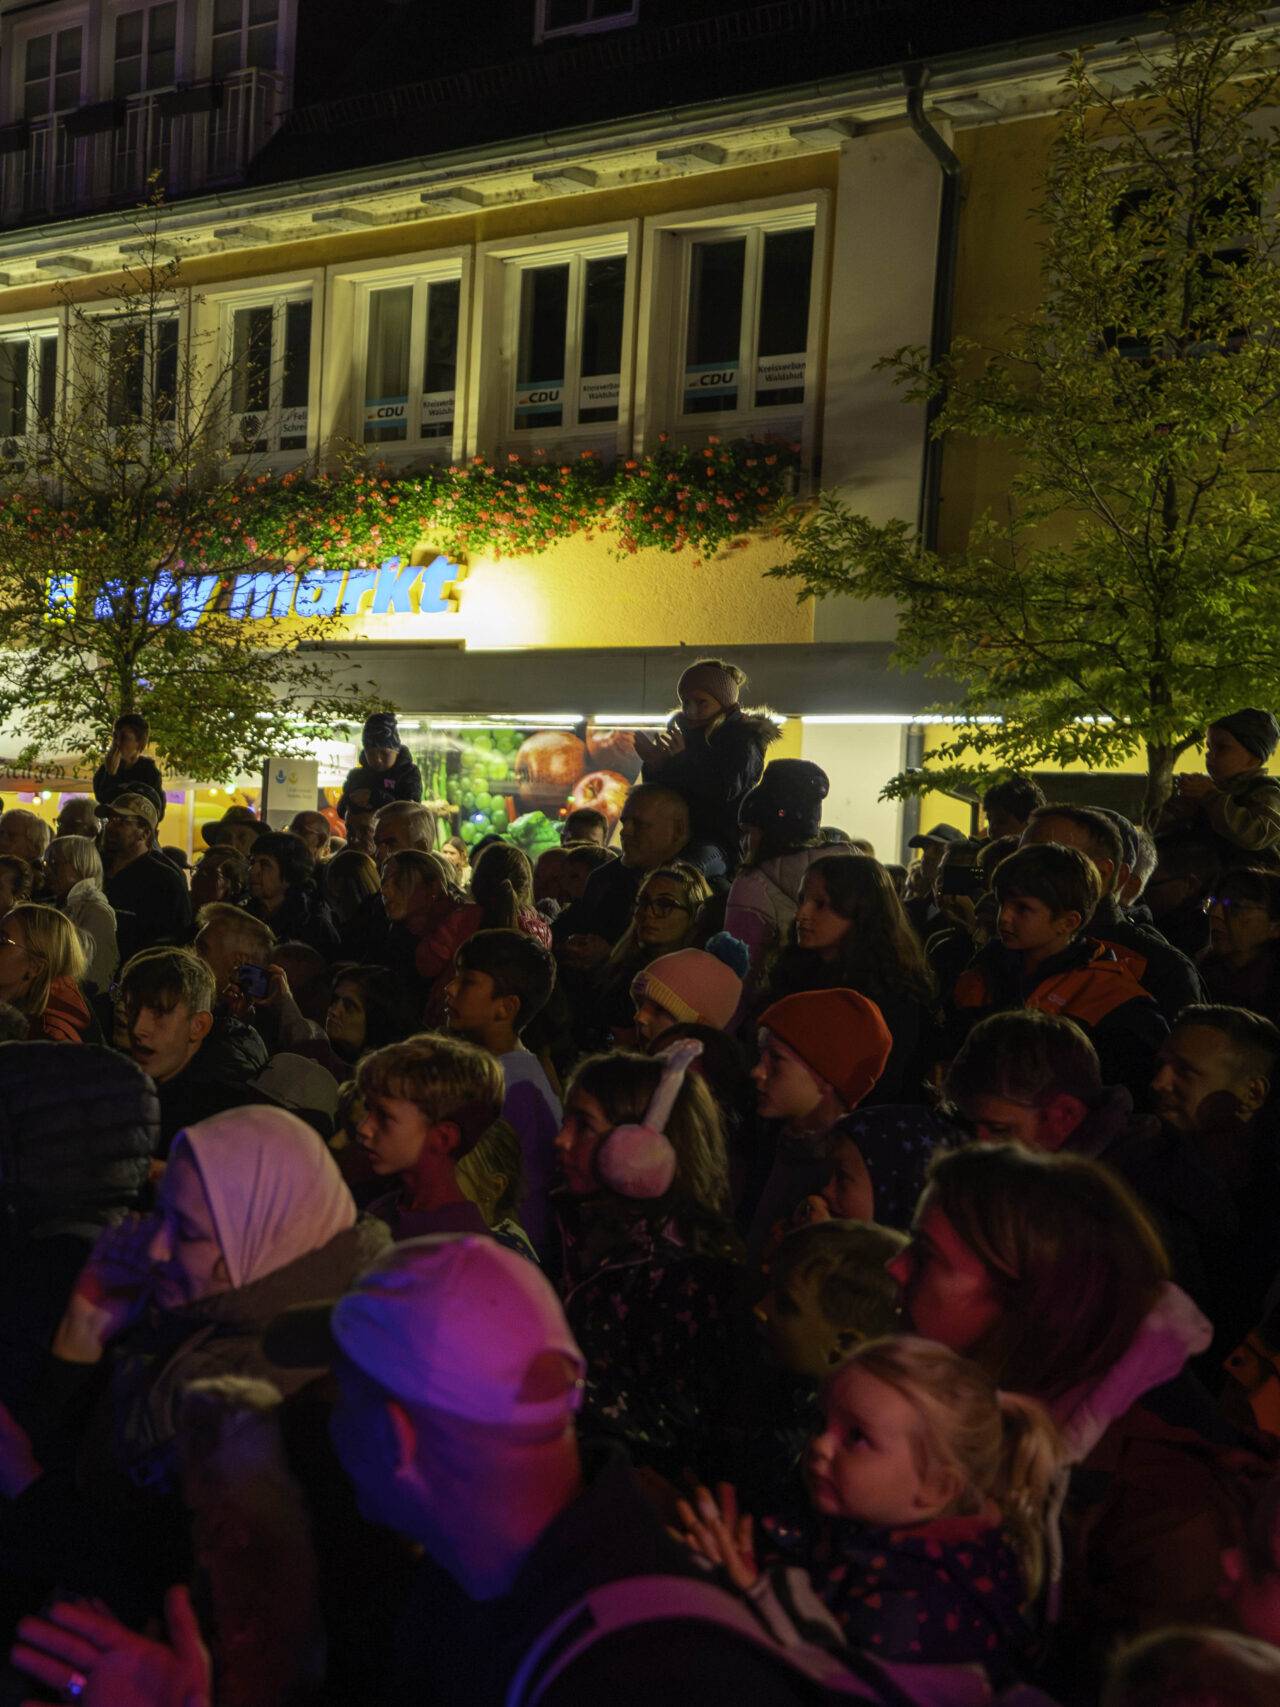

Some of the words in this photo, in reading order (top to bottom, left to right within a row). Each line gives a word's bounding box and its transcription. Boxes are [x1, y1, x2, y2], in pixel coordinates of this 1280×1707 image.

[700, 371, 734, 386] CDU
[529, 390, 560, 404] CDU
[377, 405, 405, 418] CDU
[229, 555, 460, 619] markt
